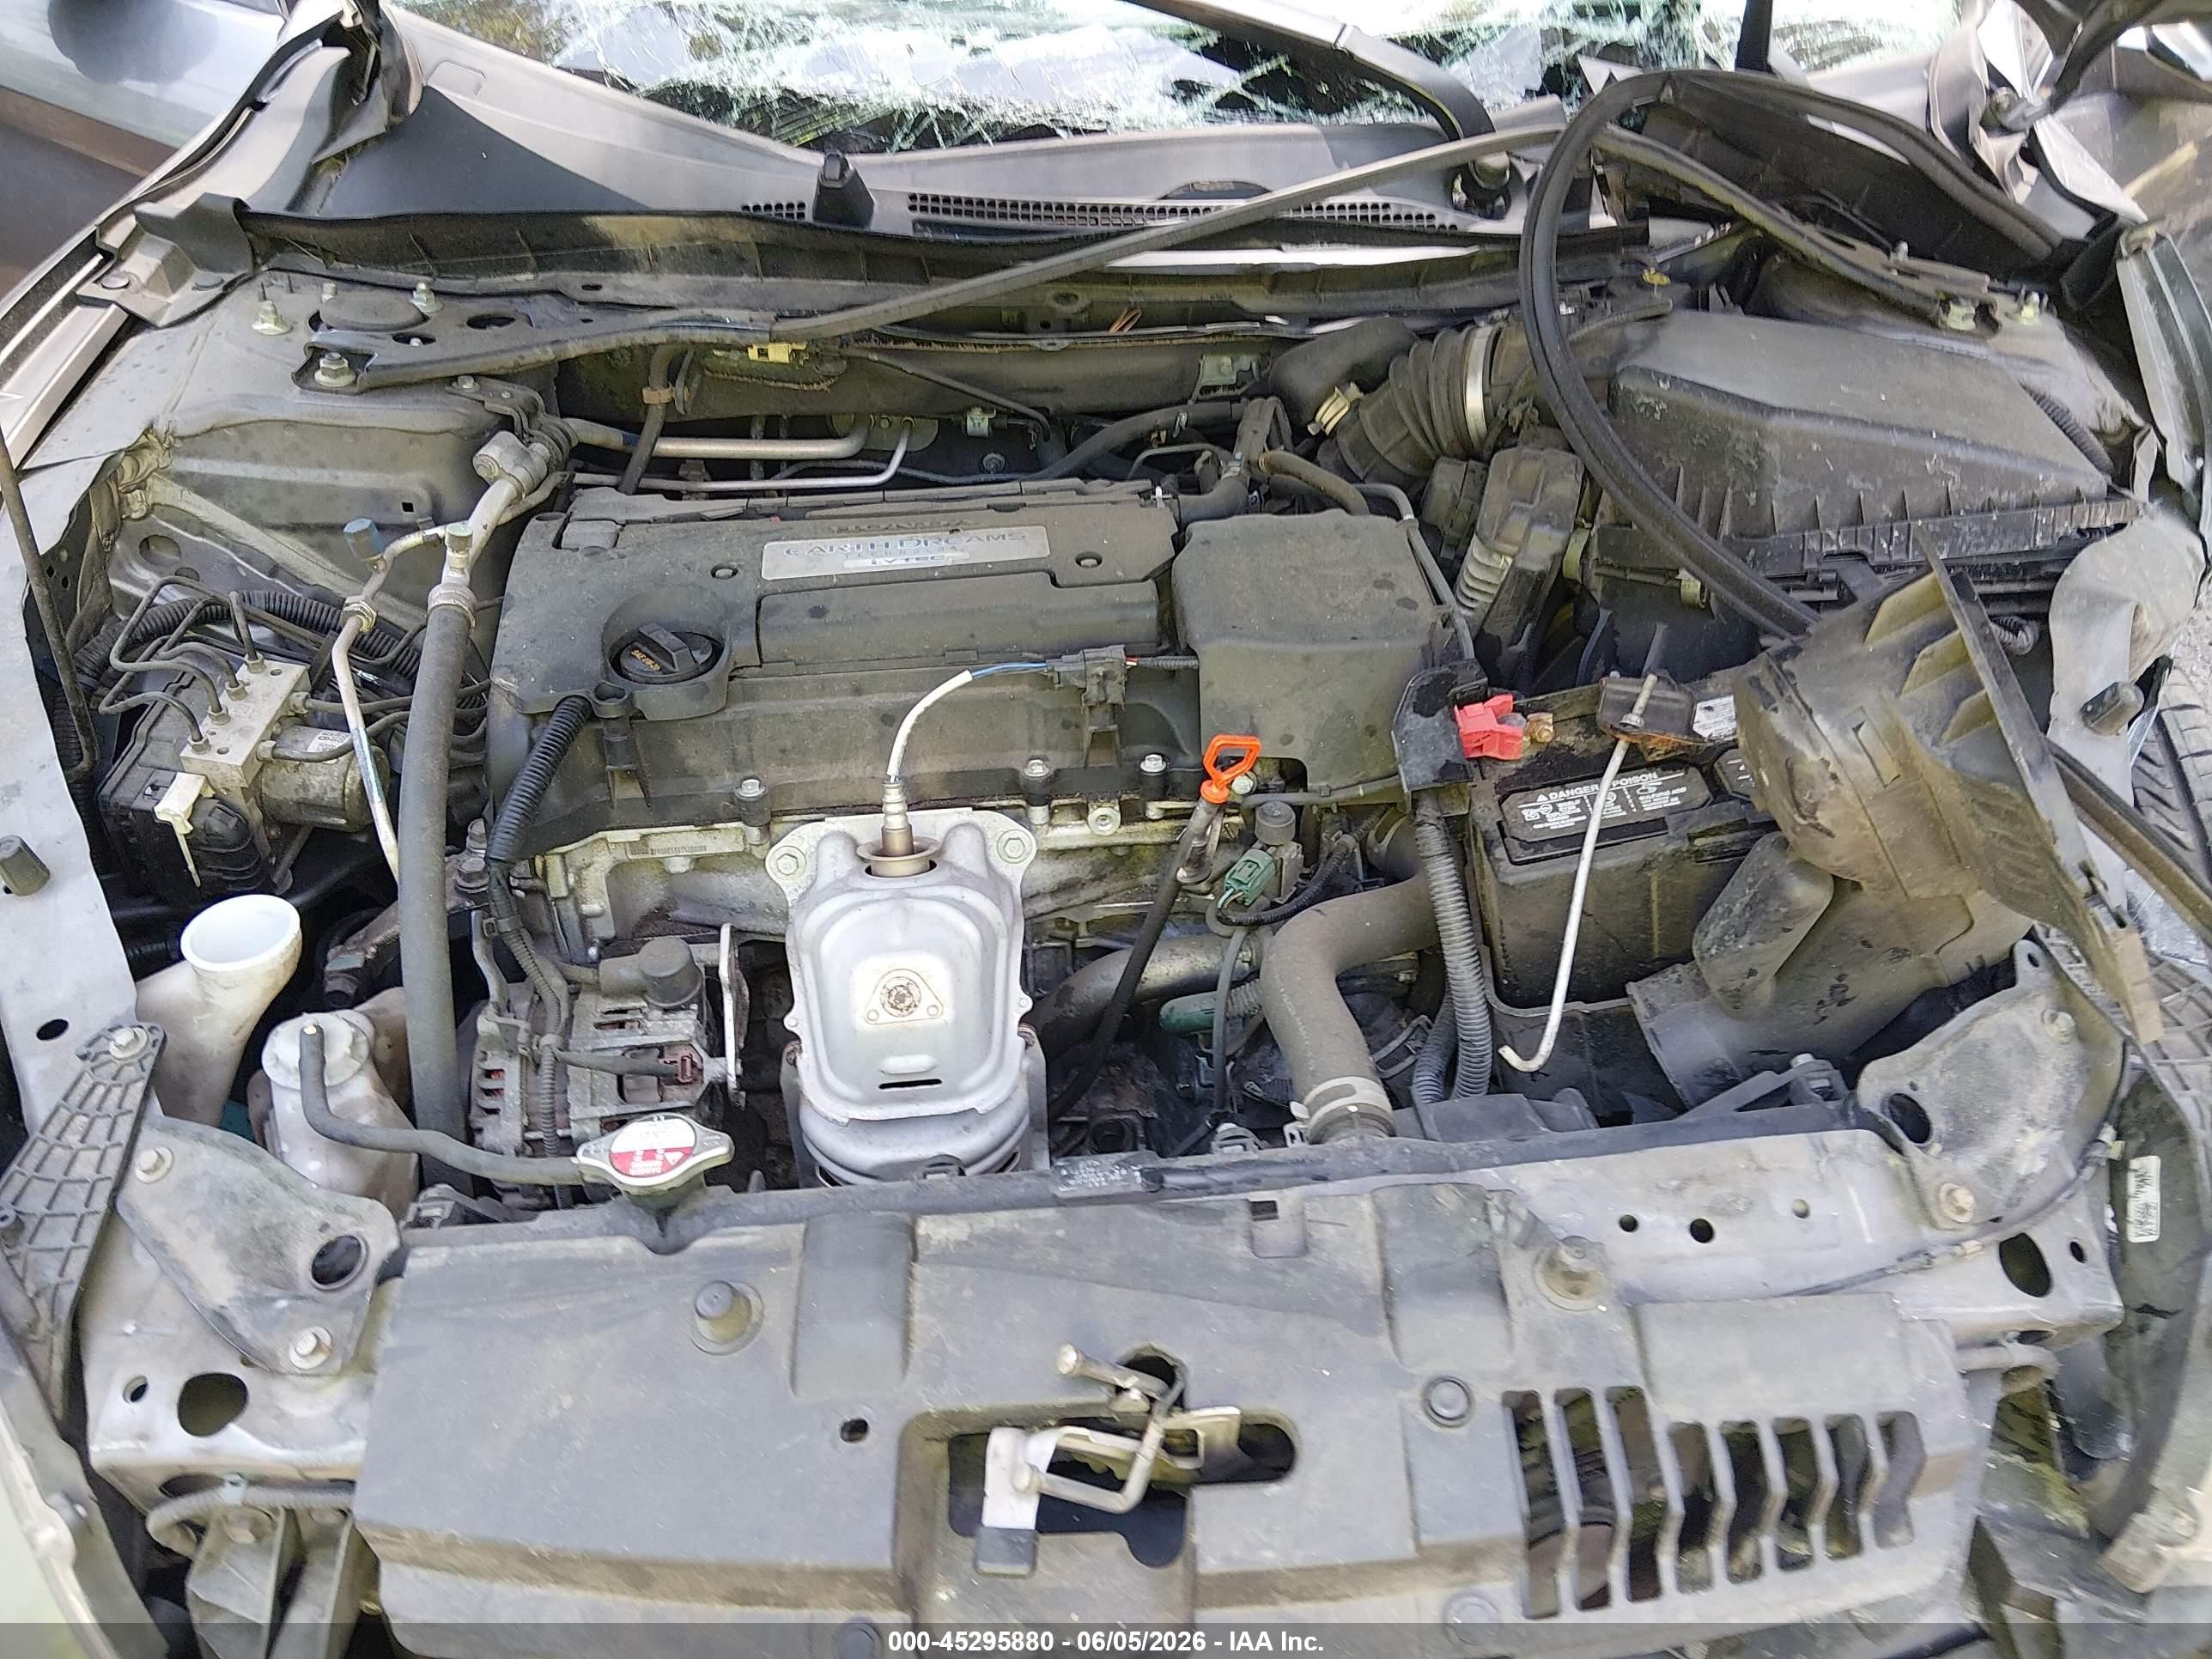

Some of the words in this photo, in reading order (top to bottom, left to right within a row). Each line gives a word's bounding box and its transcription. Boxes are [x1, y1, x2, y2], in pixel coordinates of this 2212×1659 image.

[785, 542, 890, 556] EARTH
[897, 532, 1026, 549] DREAMS
[1548, 783, 1600, 800] DANGER
[1612, 771, 1659, 787] POISON
